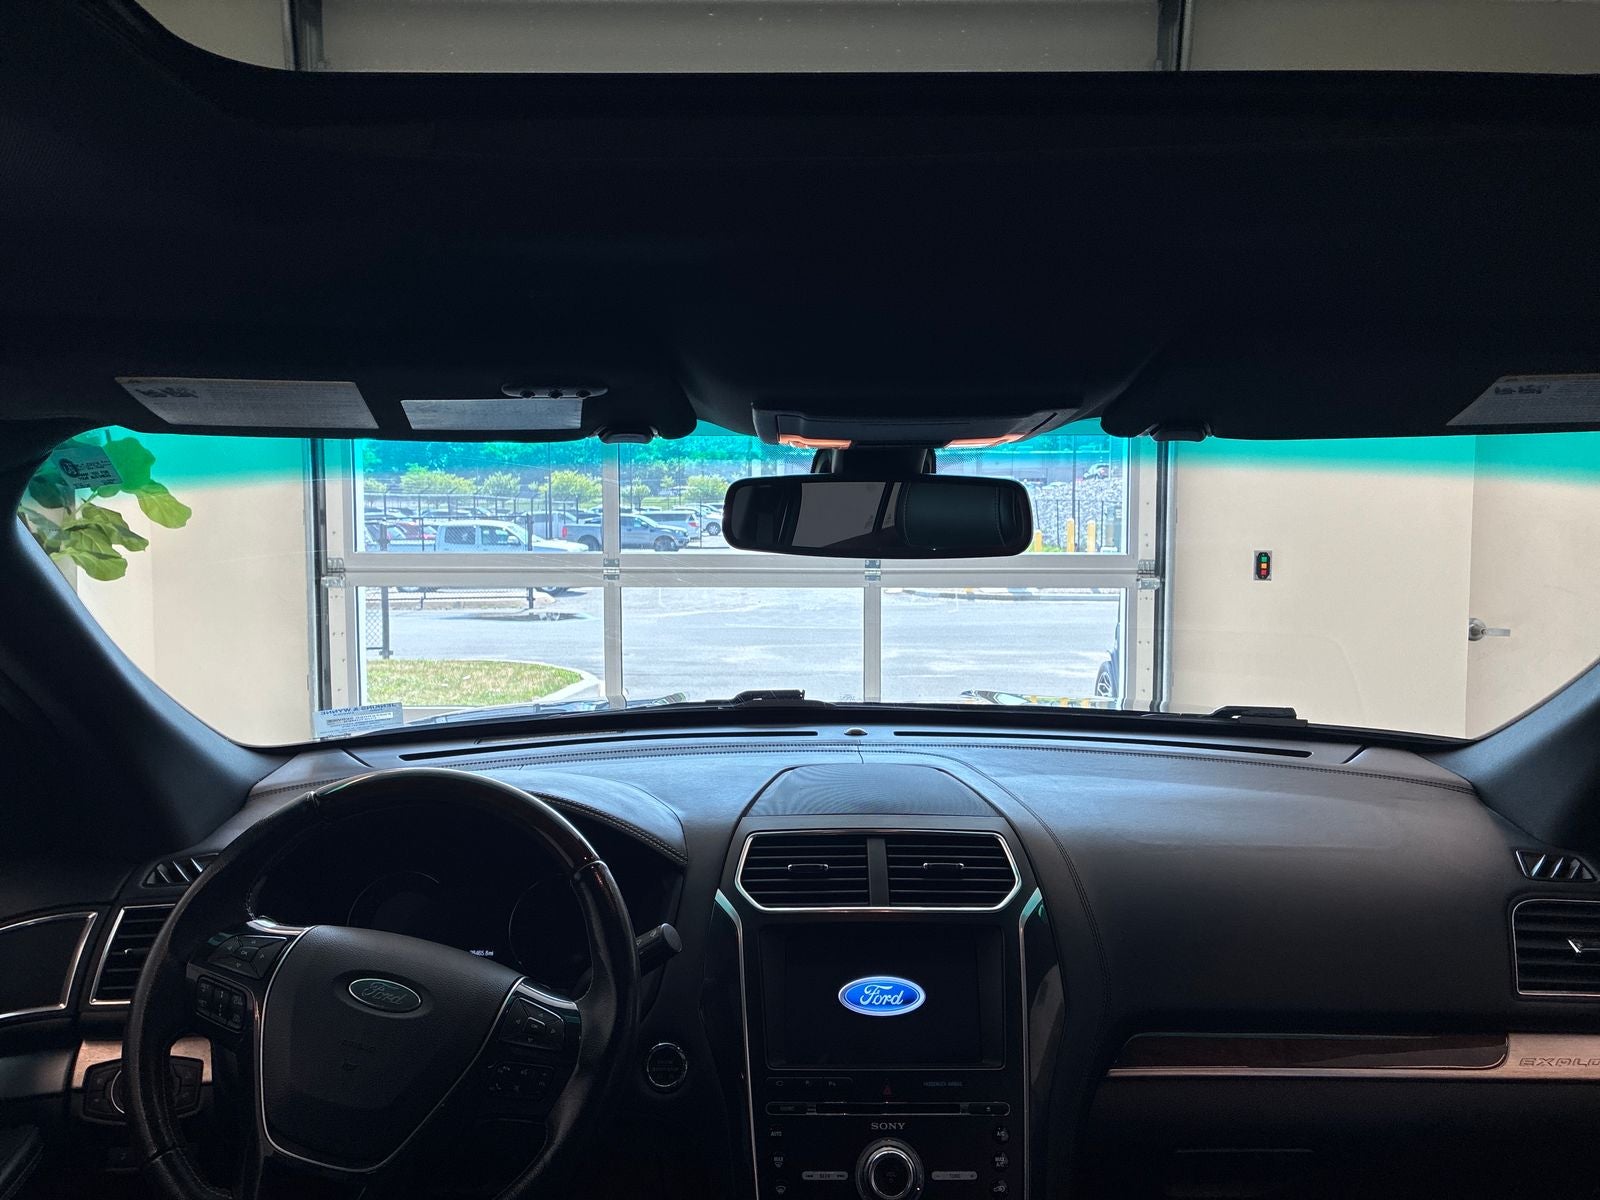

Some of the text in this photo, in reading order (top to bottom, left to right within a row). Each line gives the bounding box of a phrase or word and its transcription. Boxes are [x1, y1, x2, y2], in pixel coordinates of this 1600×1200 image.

[361, 981, 408, 1005] Ford
[860, 984, 904, 1006] Ford
[1519, 1057, 1600, 1067] EXPLO
[871, 1122, 906, 1130] SONY
